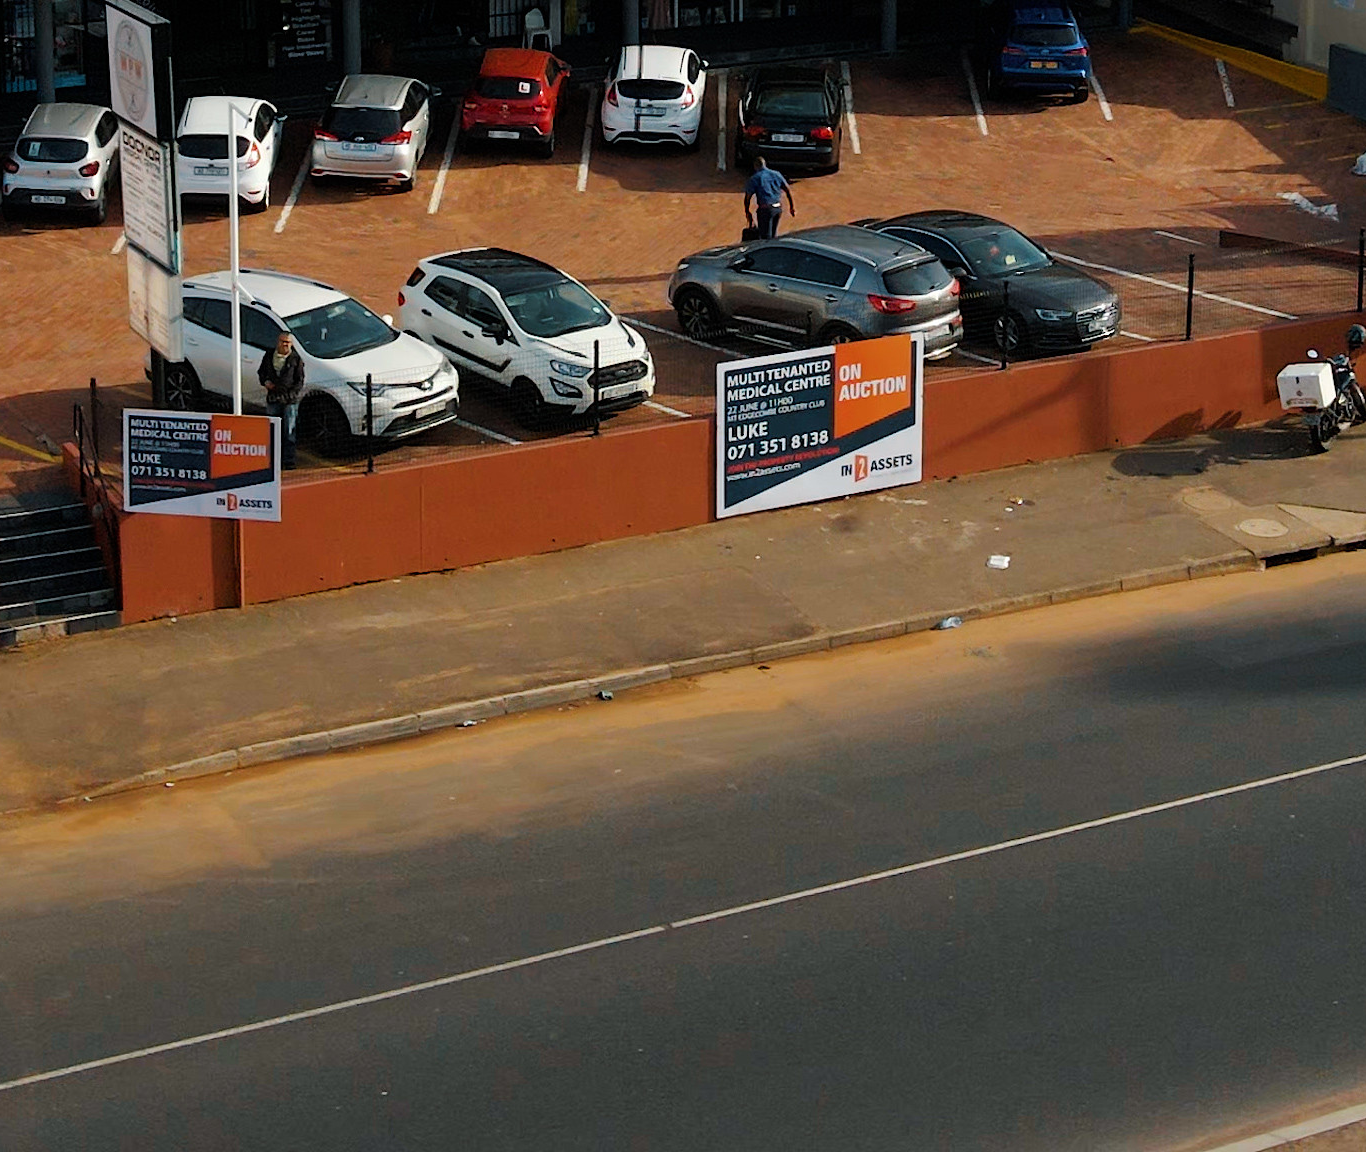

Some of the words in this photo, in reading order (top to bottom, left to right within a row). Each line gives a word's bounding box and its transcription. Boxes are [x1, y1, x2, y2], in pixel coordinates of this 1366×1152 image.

[727, 371, 765, 388] MULTI
[766, 360, 831, 381] TENANTED
[839, 363, 862, 381] ON
[727, 383, 783, 403] MEDICAL
[784, 374, 831, 392] CENTRE
[839, 375, 907, 401] AUCTION
[738, 401, 759, 412] JUNE
[131, 418, 157, 428] MULTI
[159, 421, 209, 432] TENANTED
[728, 421, 768, 442] LUKE
[131, 428, 171, 440] MEDICAL
[173, 431, 209, 442] CENTRE
[214, 429, 232, 442] ON
[214, 444, 267, 456] AUCTION
[727, 443, 755, 460] 071
[759, 438, 786, 454] 351
[791, 430, 829, 449] 8138
[131, 452, 161, 464] LUKE
[841, 464, 852, 476] IN
[870, 454, 913, 472] ASSETS
[131, 465, 152, 476] 071
[155, 467, 175, 478] 351
[178, 468, 207, 480] 8138
[216, 497, 225, 506] IN
[239, 498, 273, 509] ASSETS
